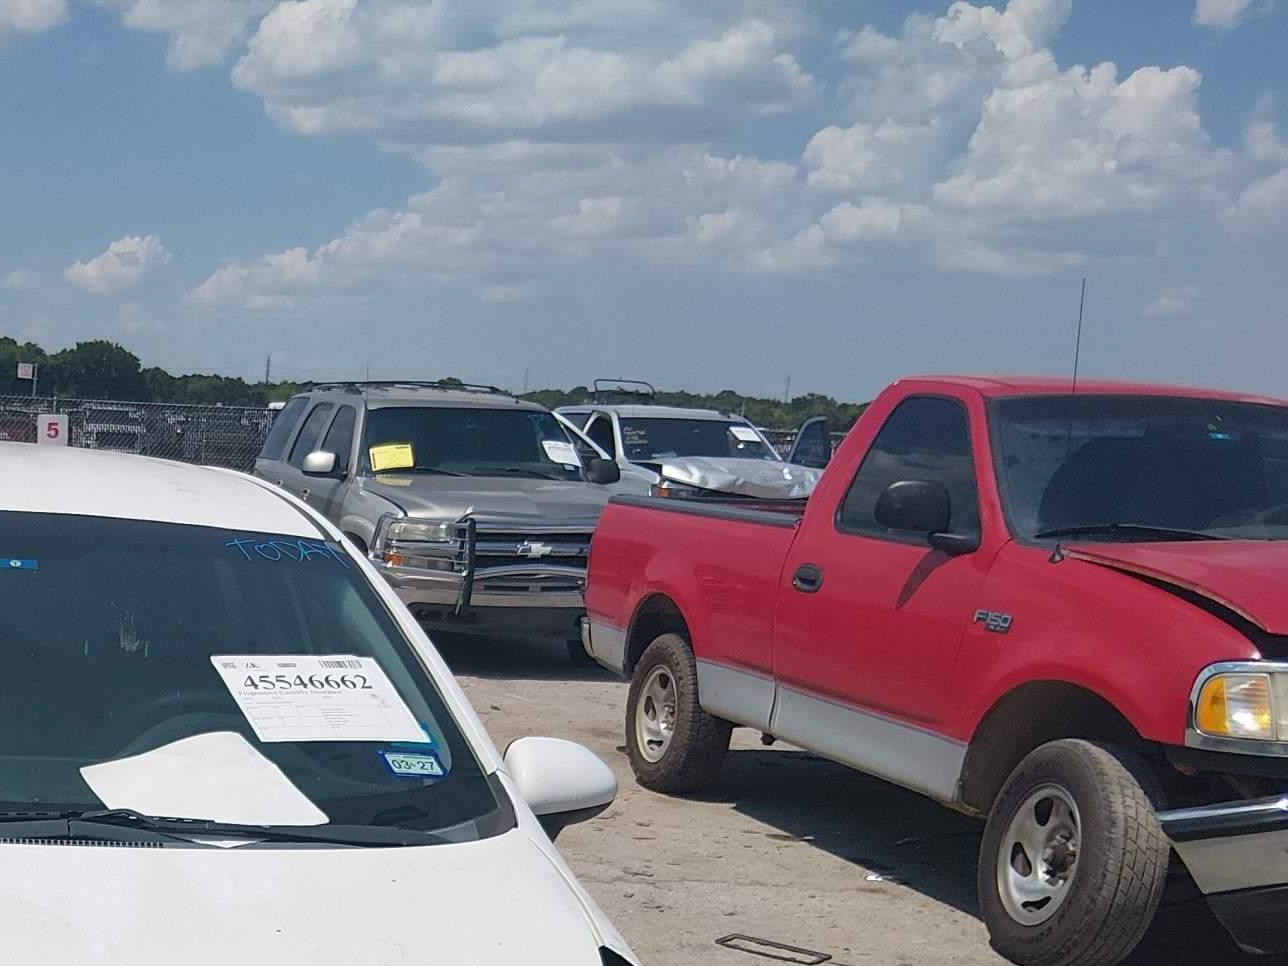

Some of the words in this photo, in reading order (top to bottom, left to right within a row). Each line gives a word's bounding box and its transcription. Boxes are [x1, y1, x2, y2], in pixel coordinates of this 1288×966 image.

[46, 422, 59, 439] 5
[225, 538, 350, 568] TODAY
[244, 674, 373, 690] 45546662
